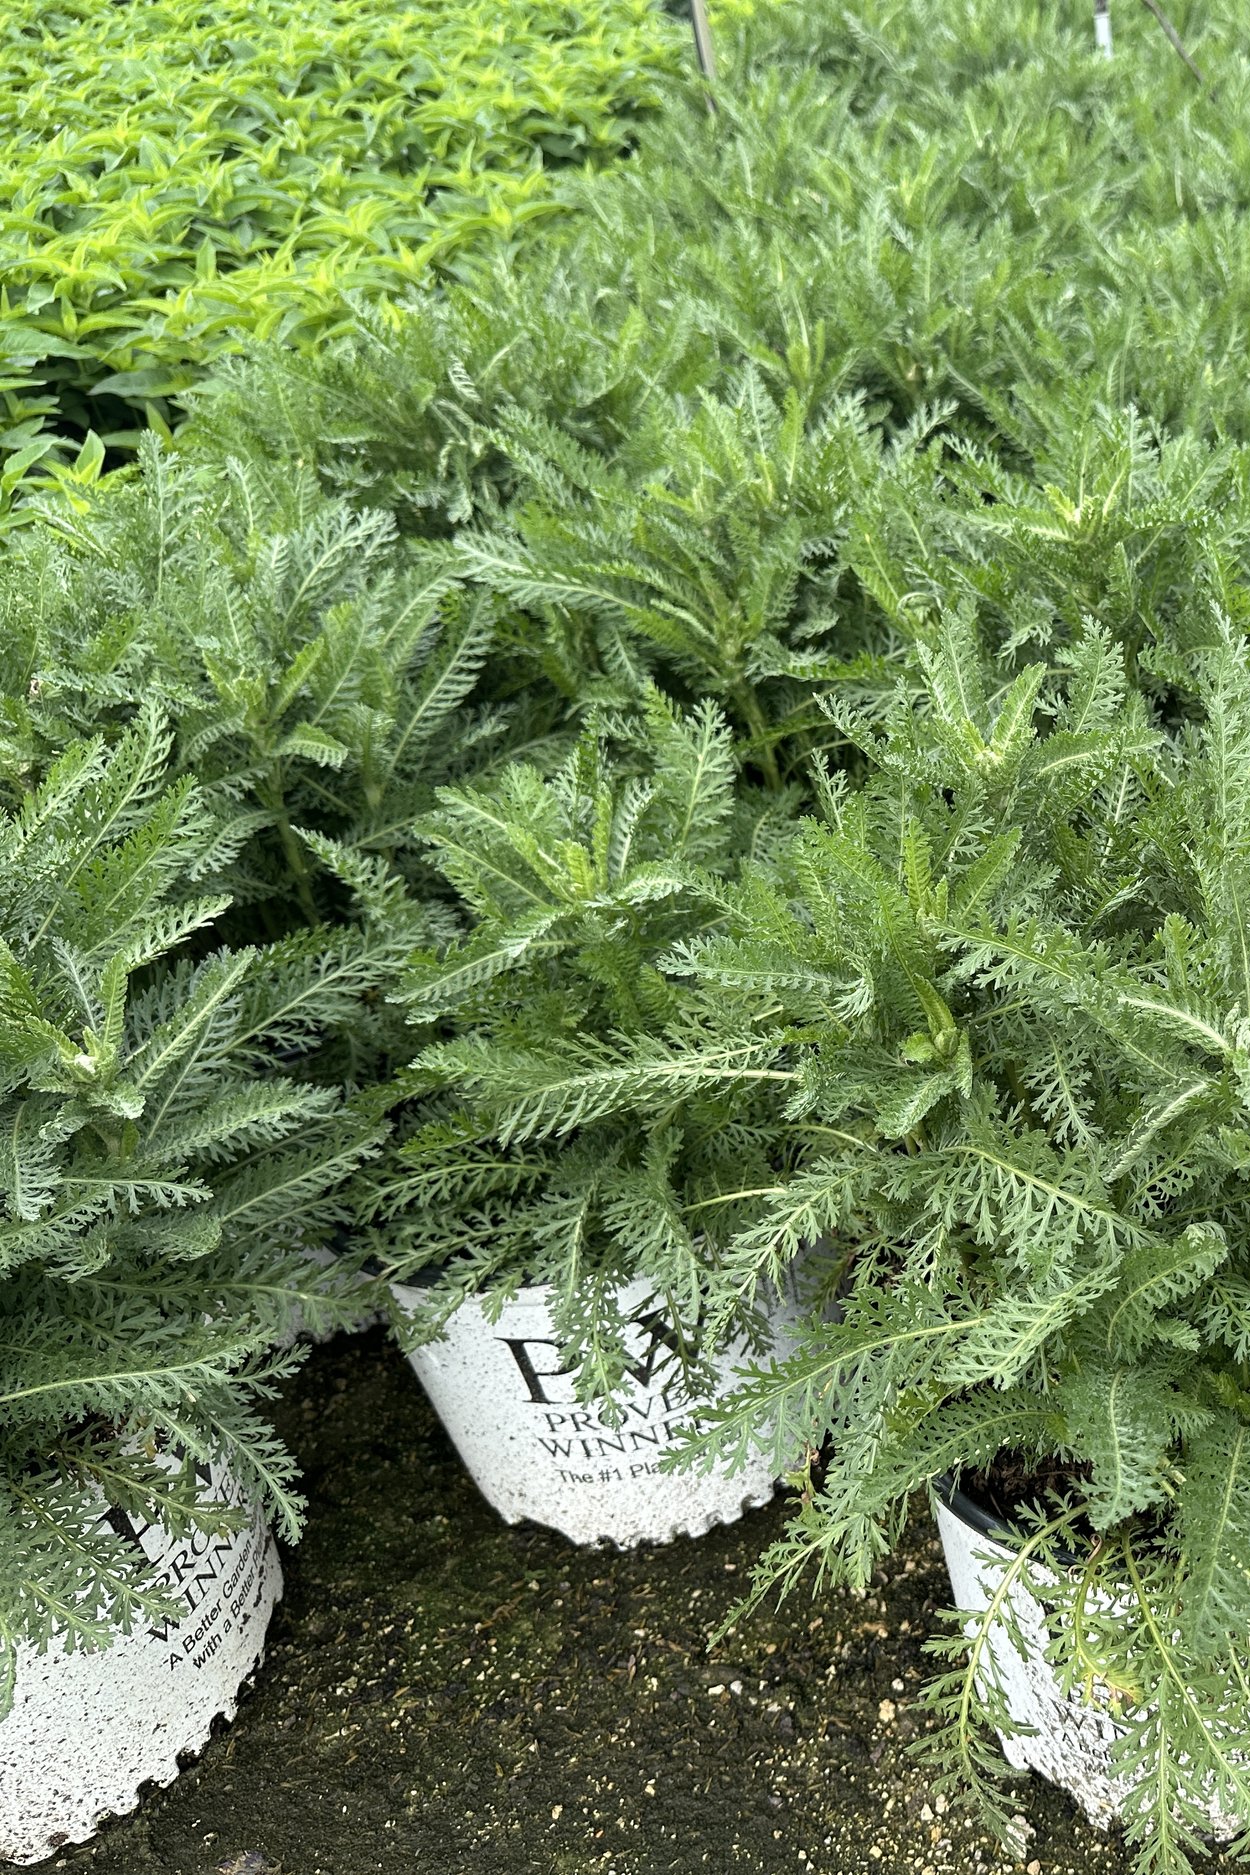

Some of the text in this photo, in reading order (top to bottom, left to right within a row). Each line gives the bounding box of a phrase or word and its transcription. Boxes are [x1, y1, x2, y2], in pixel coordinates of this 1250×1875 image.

[543, 1386, 702, 1432] PROVE
[555, 1461, 666, 1484] The #1 Pla
[170, 1539, 252, 1671] A Better Garden
[193, 1570, 255, 1669] with a Better
